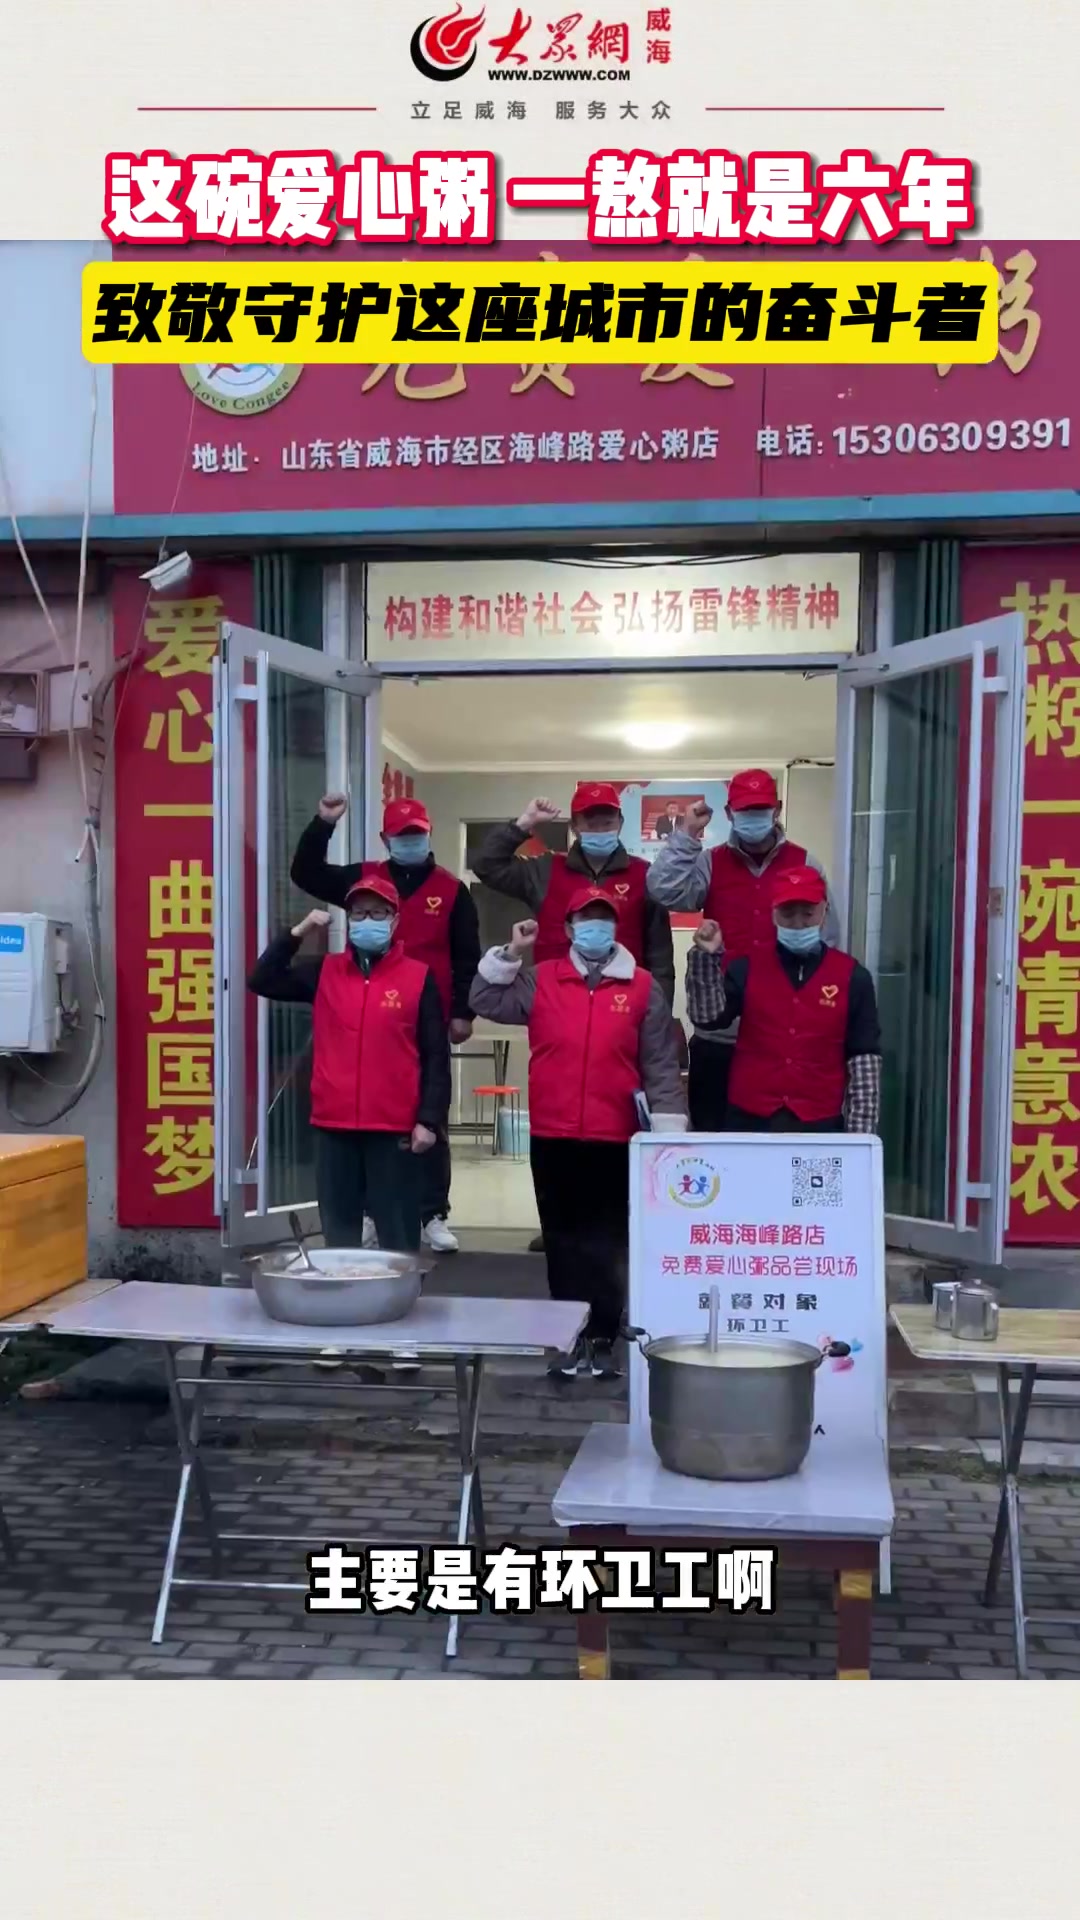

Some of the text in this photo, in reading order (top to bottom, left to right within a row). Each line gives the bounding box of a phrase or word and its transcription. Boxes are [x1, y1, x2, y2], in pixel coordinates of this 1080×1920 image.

[191, 379, 291, 411] Love Congee
[281, 428, 720, 471] 山东省威海市经区海峰路爱心粥店
[384, 582, 840, 641] 构建和谐社会弘扬雷锋精神
[143, 596, 221, 1196] 爱心一曲强国梦
[0, 935, 22, 945] idea
[689, 1223, 826, 1246] 威海海峰路店
[661, 1255, 858, 1278] 免费爱心粥品尝现场
[727, 1318, 790, 1333] 环卫工
